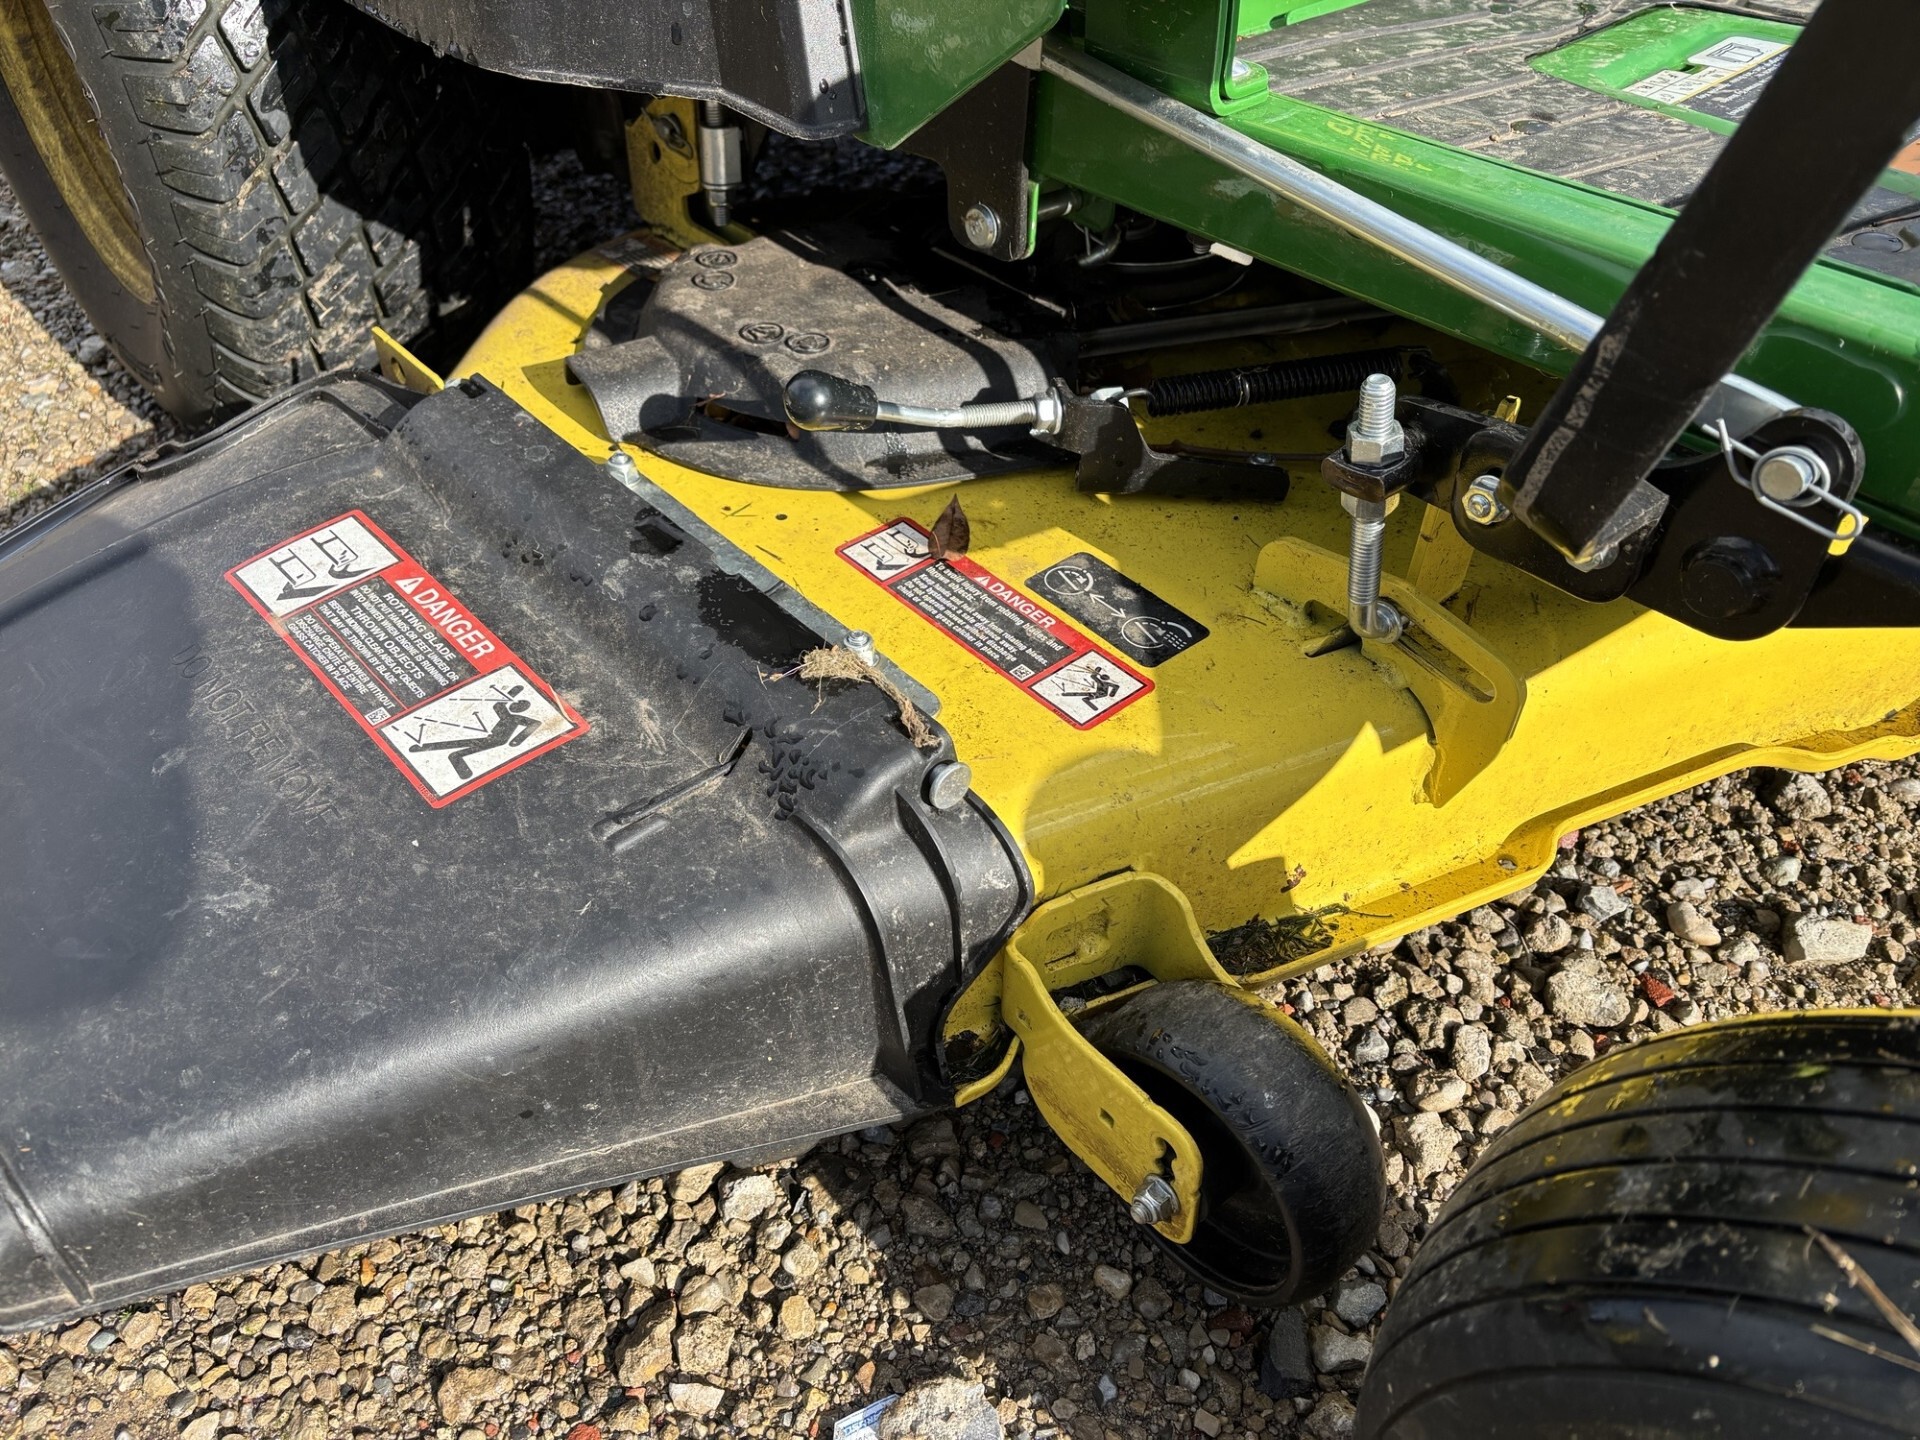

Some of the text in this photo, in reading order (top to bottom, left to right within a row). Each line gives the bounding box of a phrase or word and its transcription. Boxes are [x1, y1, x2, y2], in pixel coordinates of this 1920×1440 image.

[896, 585, 914, 597] chute
[918, 601, 937, 614] entire
[934, 613, 954, 627] grass
[952, 625, 976, 642] catcher
[910, 578, 928, 589] Keep
[924, 588, 958, 611] bystanders
[961, 613, 976, 623] safe
[974, 622, 1001, 641] distance
[918, 574, 935, 586] Keep
[932, 584, 952, 597] hands
[949, 595, 964, 605] and
[971, 611, 990, 624] away
[987, 622, 1004, 633] from
[1000, 632, 1027, 650] rotating
[925, 567, 977, 603] thrown objects:
[933, 562, 1064, 651] To avoid injury from rotating blades and
[987, 582, 1057, 628] DANGER
[286, 622, 352, 690] GRASS CATCHER IN PLACE
[294, 618, 369, 694] DISCHARGE CHUTE OR ENTIRE
[317, 604, 398, 684] THAT MAY BE THROWN BY BLADE
[327, 599, 427, 698] BEFORE MOWING, CLEAR AREA OF OBJECTS
[348, 605, 426, 680] THROWN OBJECTS
[349, 589, 450, 686] INTO MOWER WHEN ENGINE IS RUNNING
[358, 584, 460, 681] DO NOT PUT HANDS OR FEET UNDER OR
[381, 592, 457, 661] ROTATING BLADE
[411, 586, 498, 660] DANGER
[912, 587, 925, 595] not
[921, 594, 946, 611] operate
[943, 609, 966, 625] mower
[964, 624, 988, 641] without
[984, 640, 1017, 662] discharge
[302, 614, 396, 710] DO NOT OPERATE MOWER WITHOUT
[196, 674, 258, 728] NOT
[233, 720, 344, 828] REMOVE
